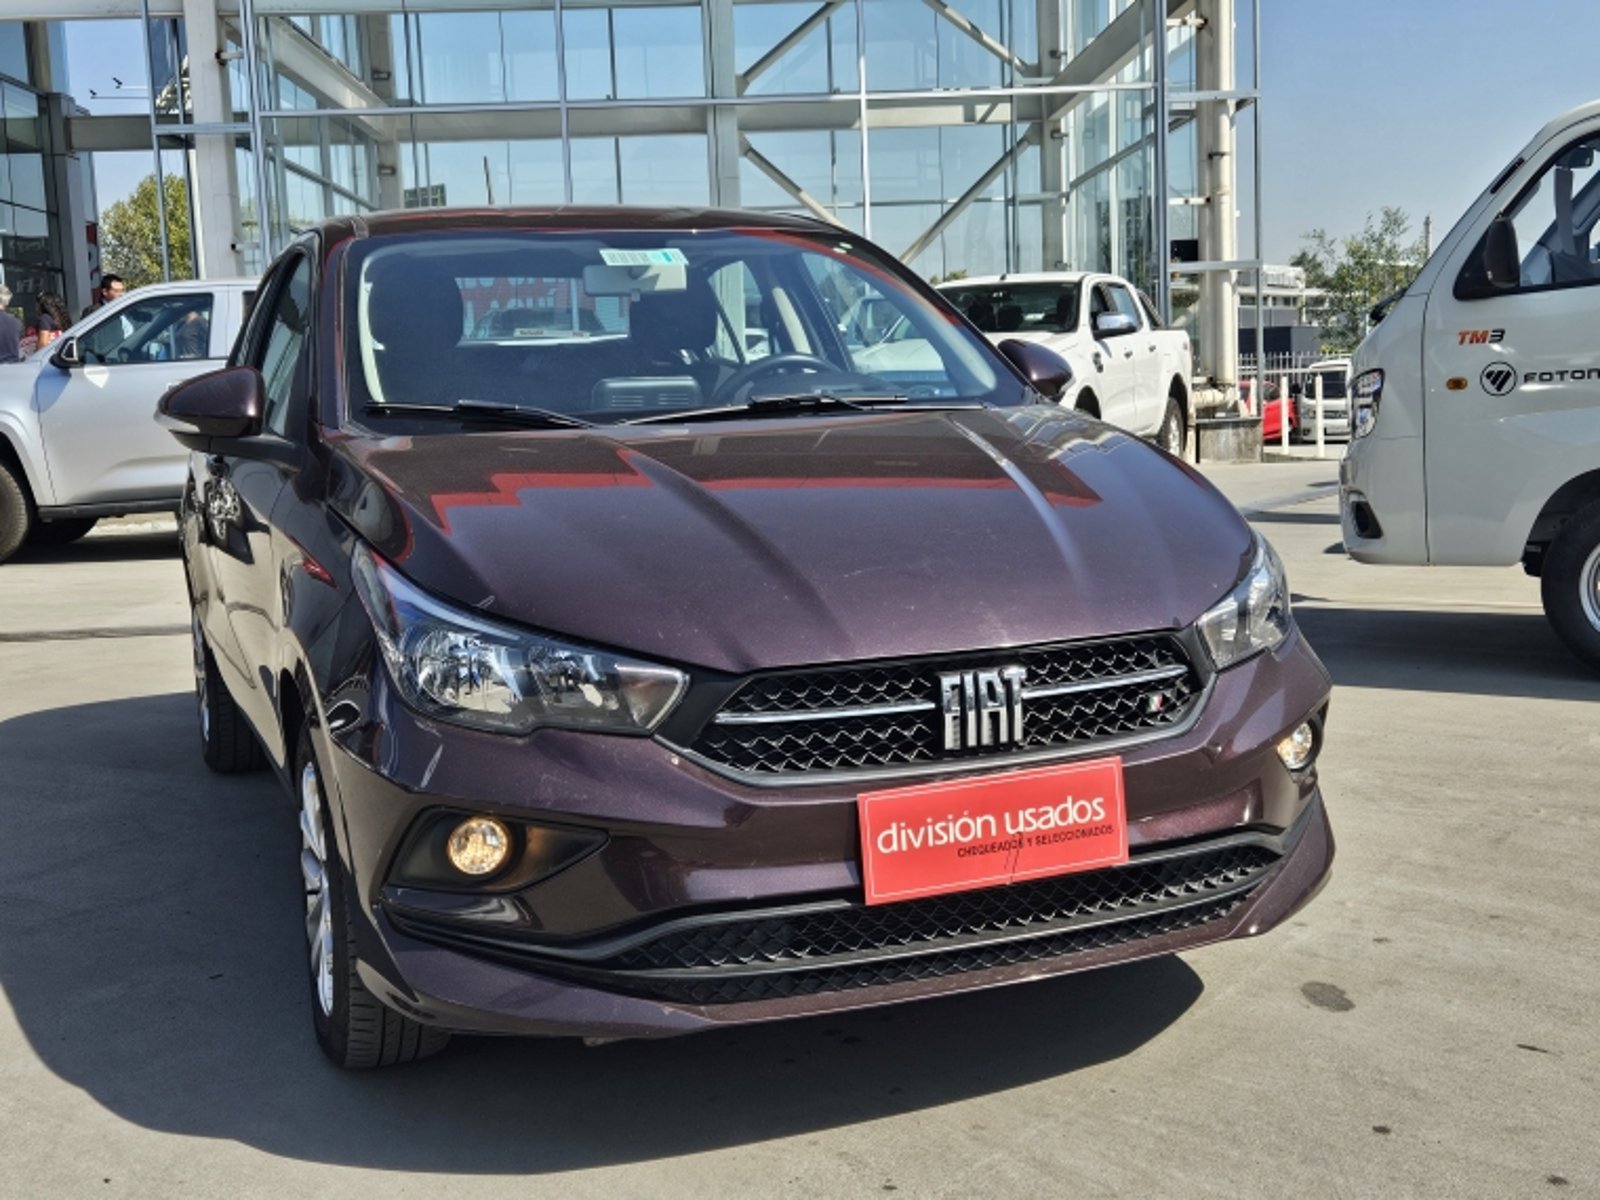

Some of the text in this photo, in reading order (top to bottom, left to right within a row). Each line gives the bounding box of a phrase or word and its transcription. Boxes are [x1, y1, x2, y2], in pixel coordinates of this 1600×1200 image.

[1458, 328, 1506, 345] TM3
[1523, 367, 1600, 383] FOTON
[939, 665, 1027, 750] FIAT
[876, 795, 1107, 854] división usados
[1035, 824, 1115, 846] SELECCIONADOS
